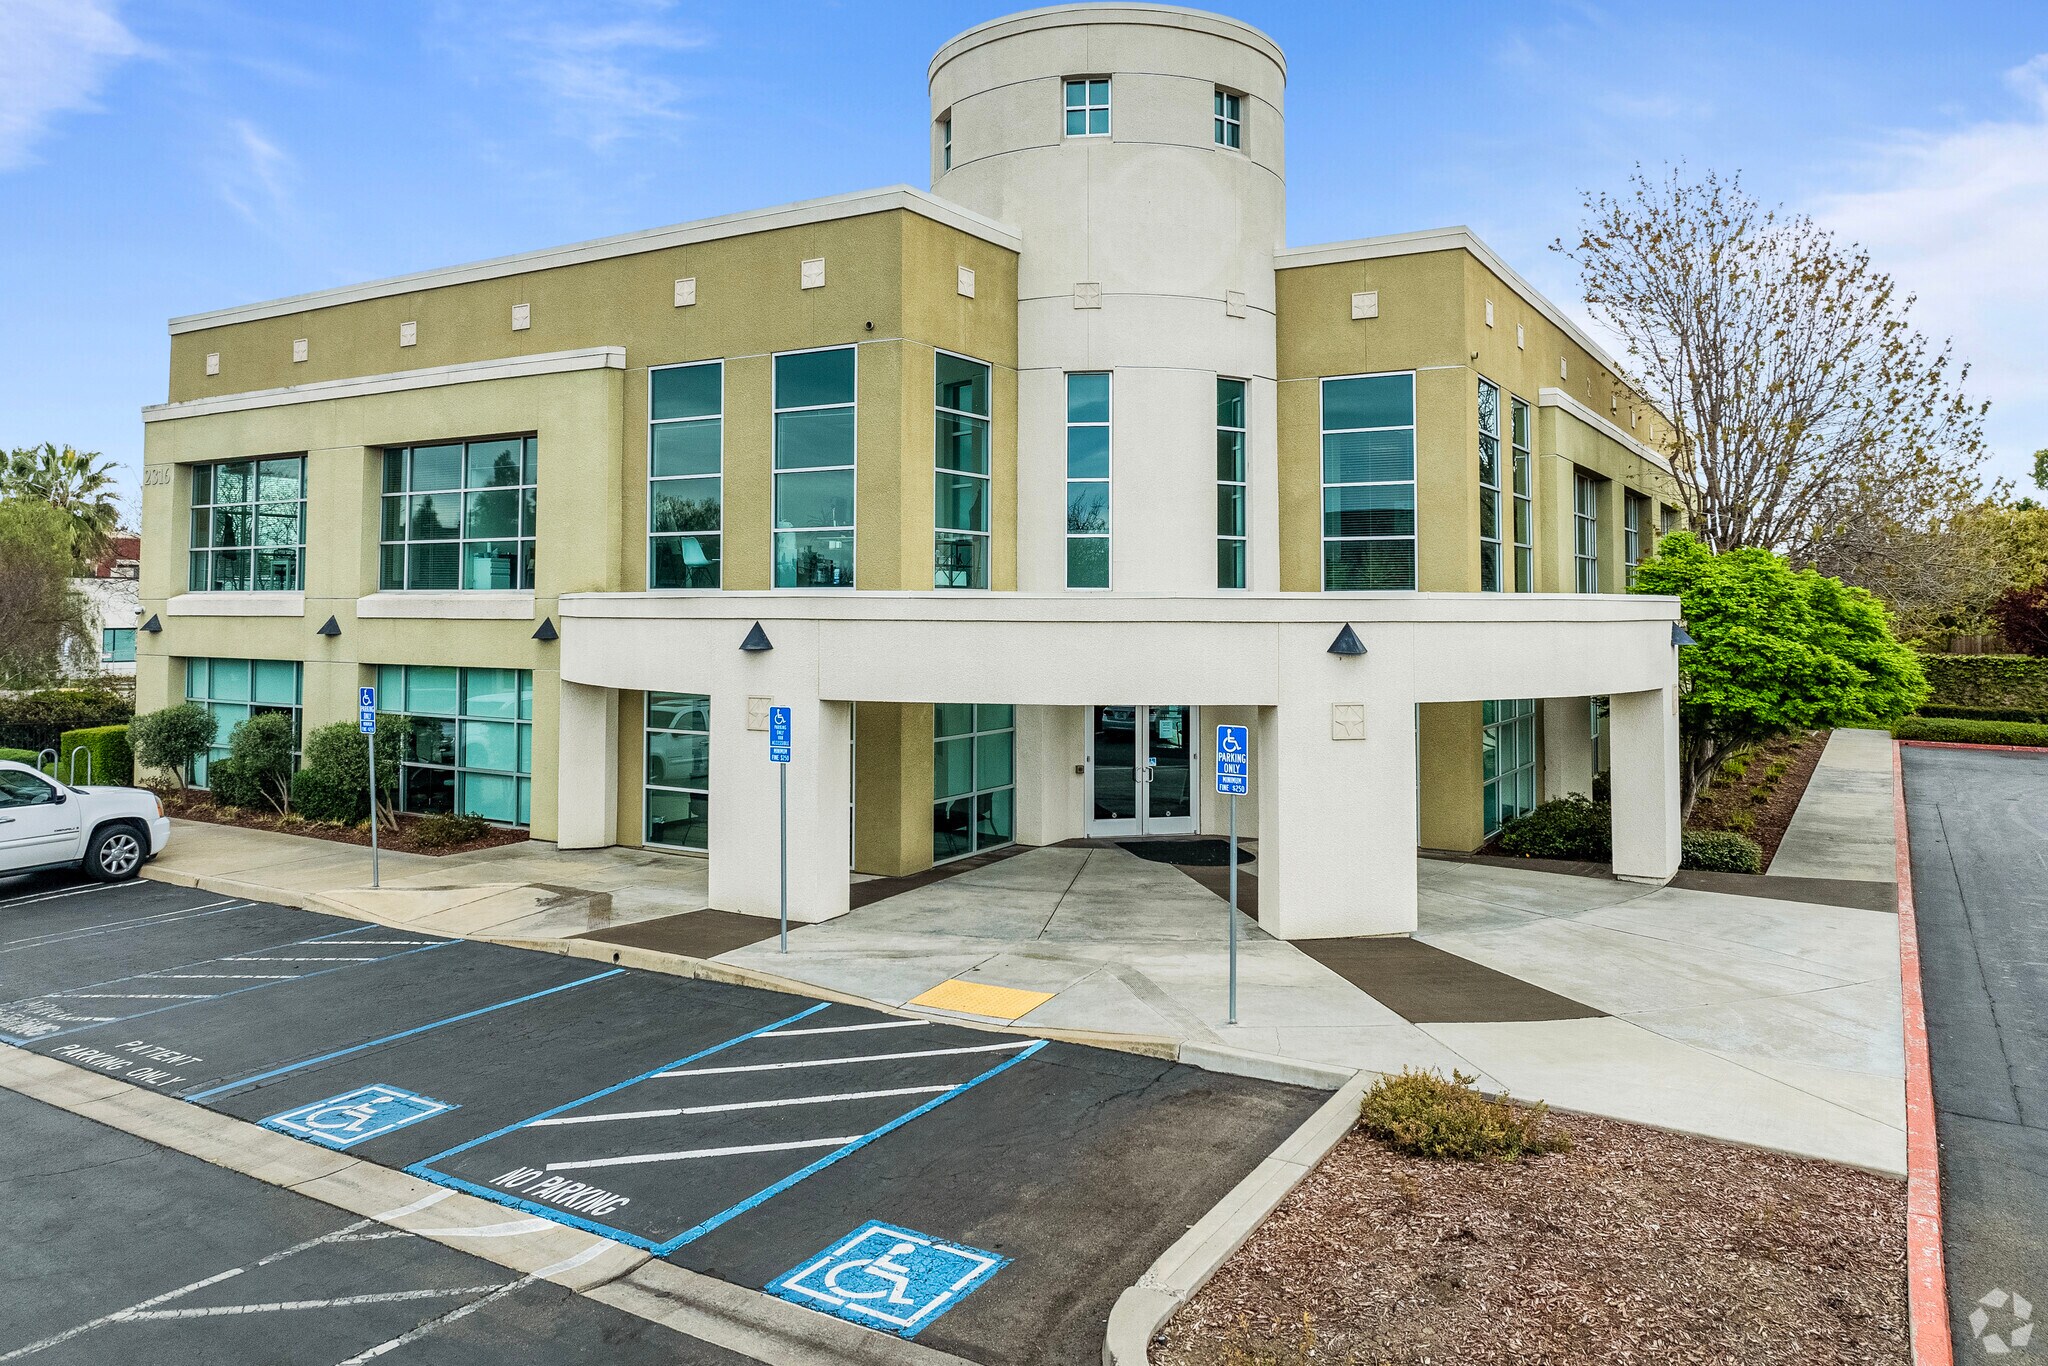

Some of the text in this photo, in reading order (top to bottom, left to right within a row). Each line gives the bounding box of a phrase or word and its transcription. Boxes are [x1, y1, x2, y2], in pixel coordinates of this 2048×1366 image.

[144, 468, 171, 486] 2316
[1218, 752, 1246, 764] PARKING
[1223, 763, 1240, 774] ONLY
[1222, 776, 1242, 784] MINIMUM
[1219, 783, 1245, 793] FINE $250
[115, 1040, 203, 1067] PATIENT
[51, 1044, 186, 1087] PARKING ONLY
[488, 1166, 631, 1217] NO PARKING
